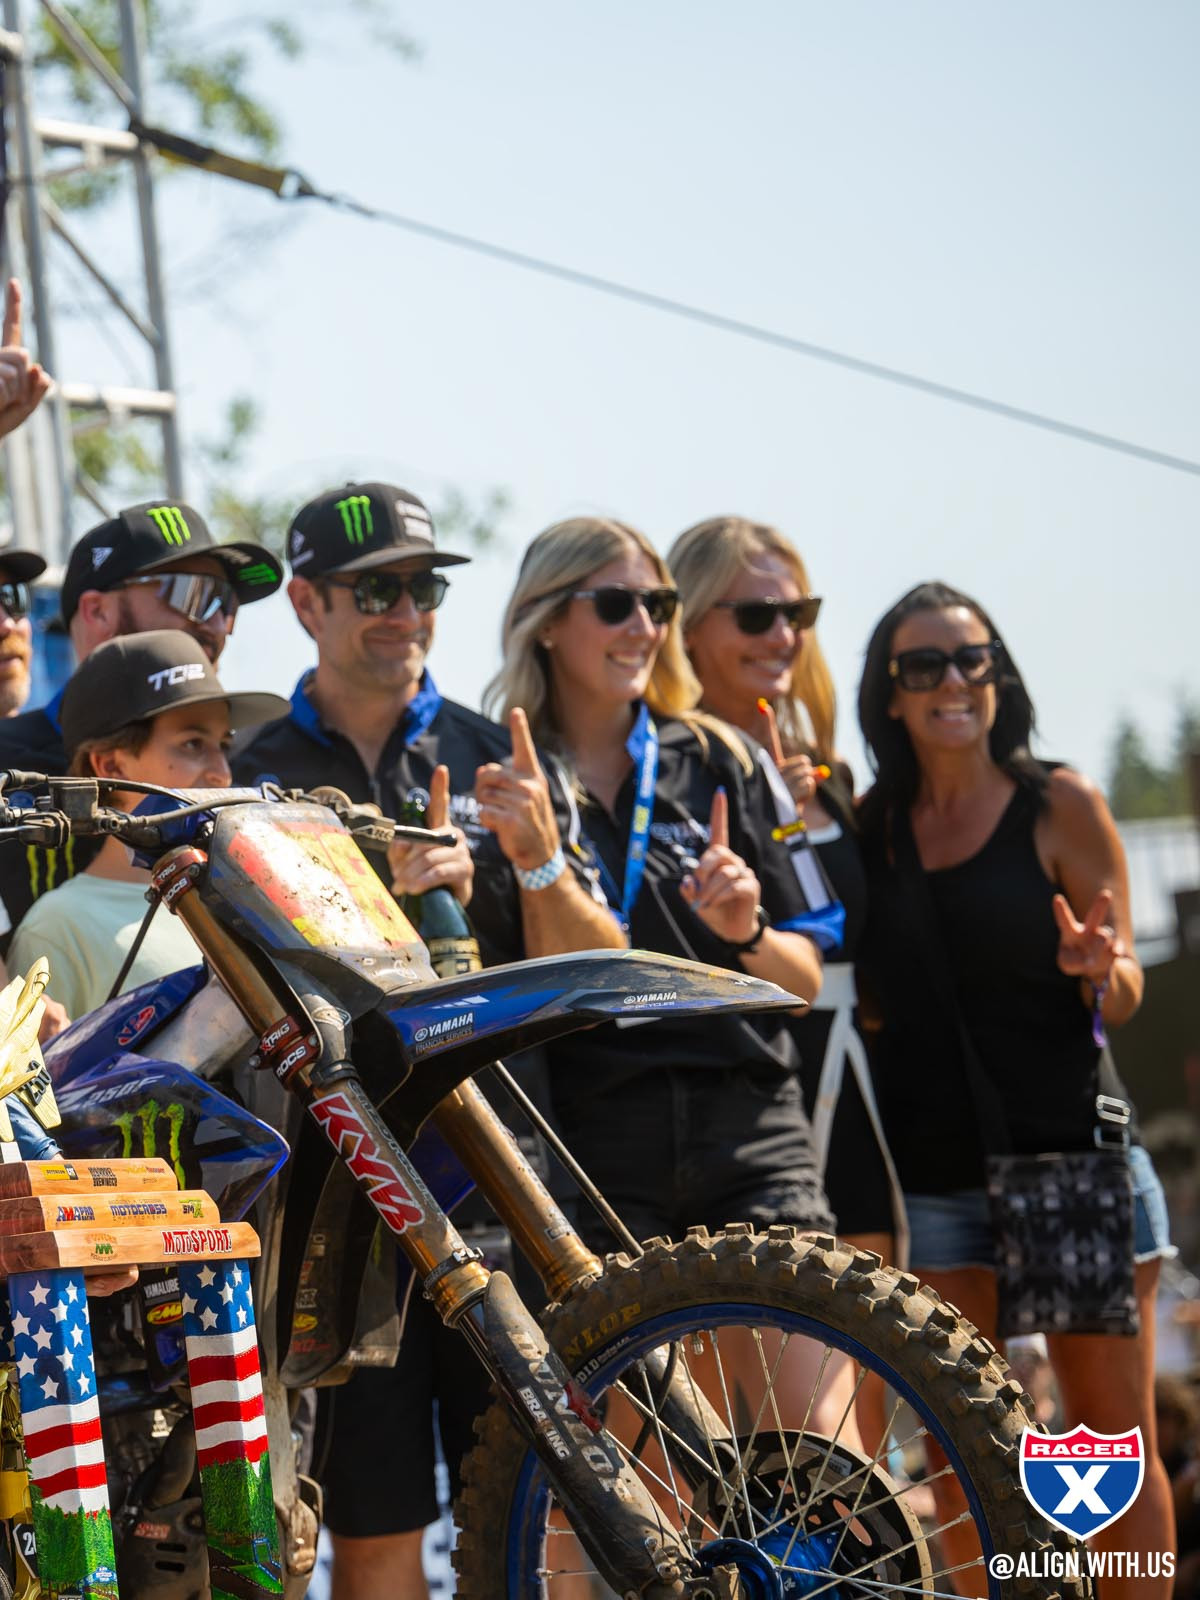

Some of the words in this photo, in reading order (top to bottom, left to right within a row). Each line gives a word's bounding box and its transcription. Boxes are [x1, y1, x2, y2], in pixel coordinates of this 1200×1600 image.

[635, 992, 677, 1003] YAMAHA
[428, 1012, 474, 1037] YAMAHA
[276, 1045, 307, 1080] ROCS
[308, 1091, 425, 1235] KYB
[56, 1206, 81, 1221] AMA
[110, 1203, 168, 1217] MOTOCROSS
[143, 1277, 180, 1299] YAMALUBE
[519, 1388, 571, 1460] BRAKING
